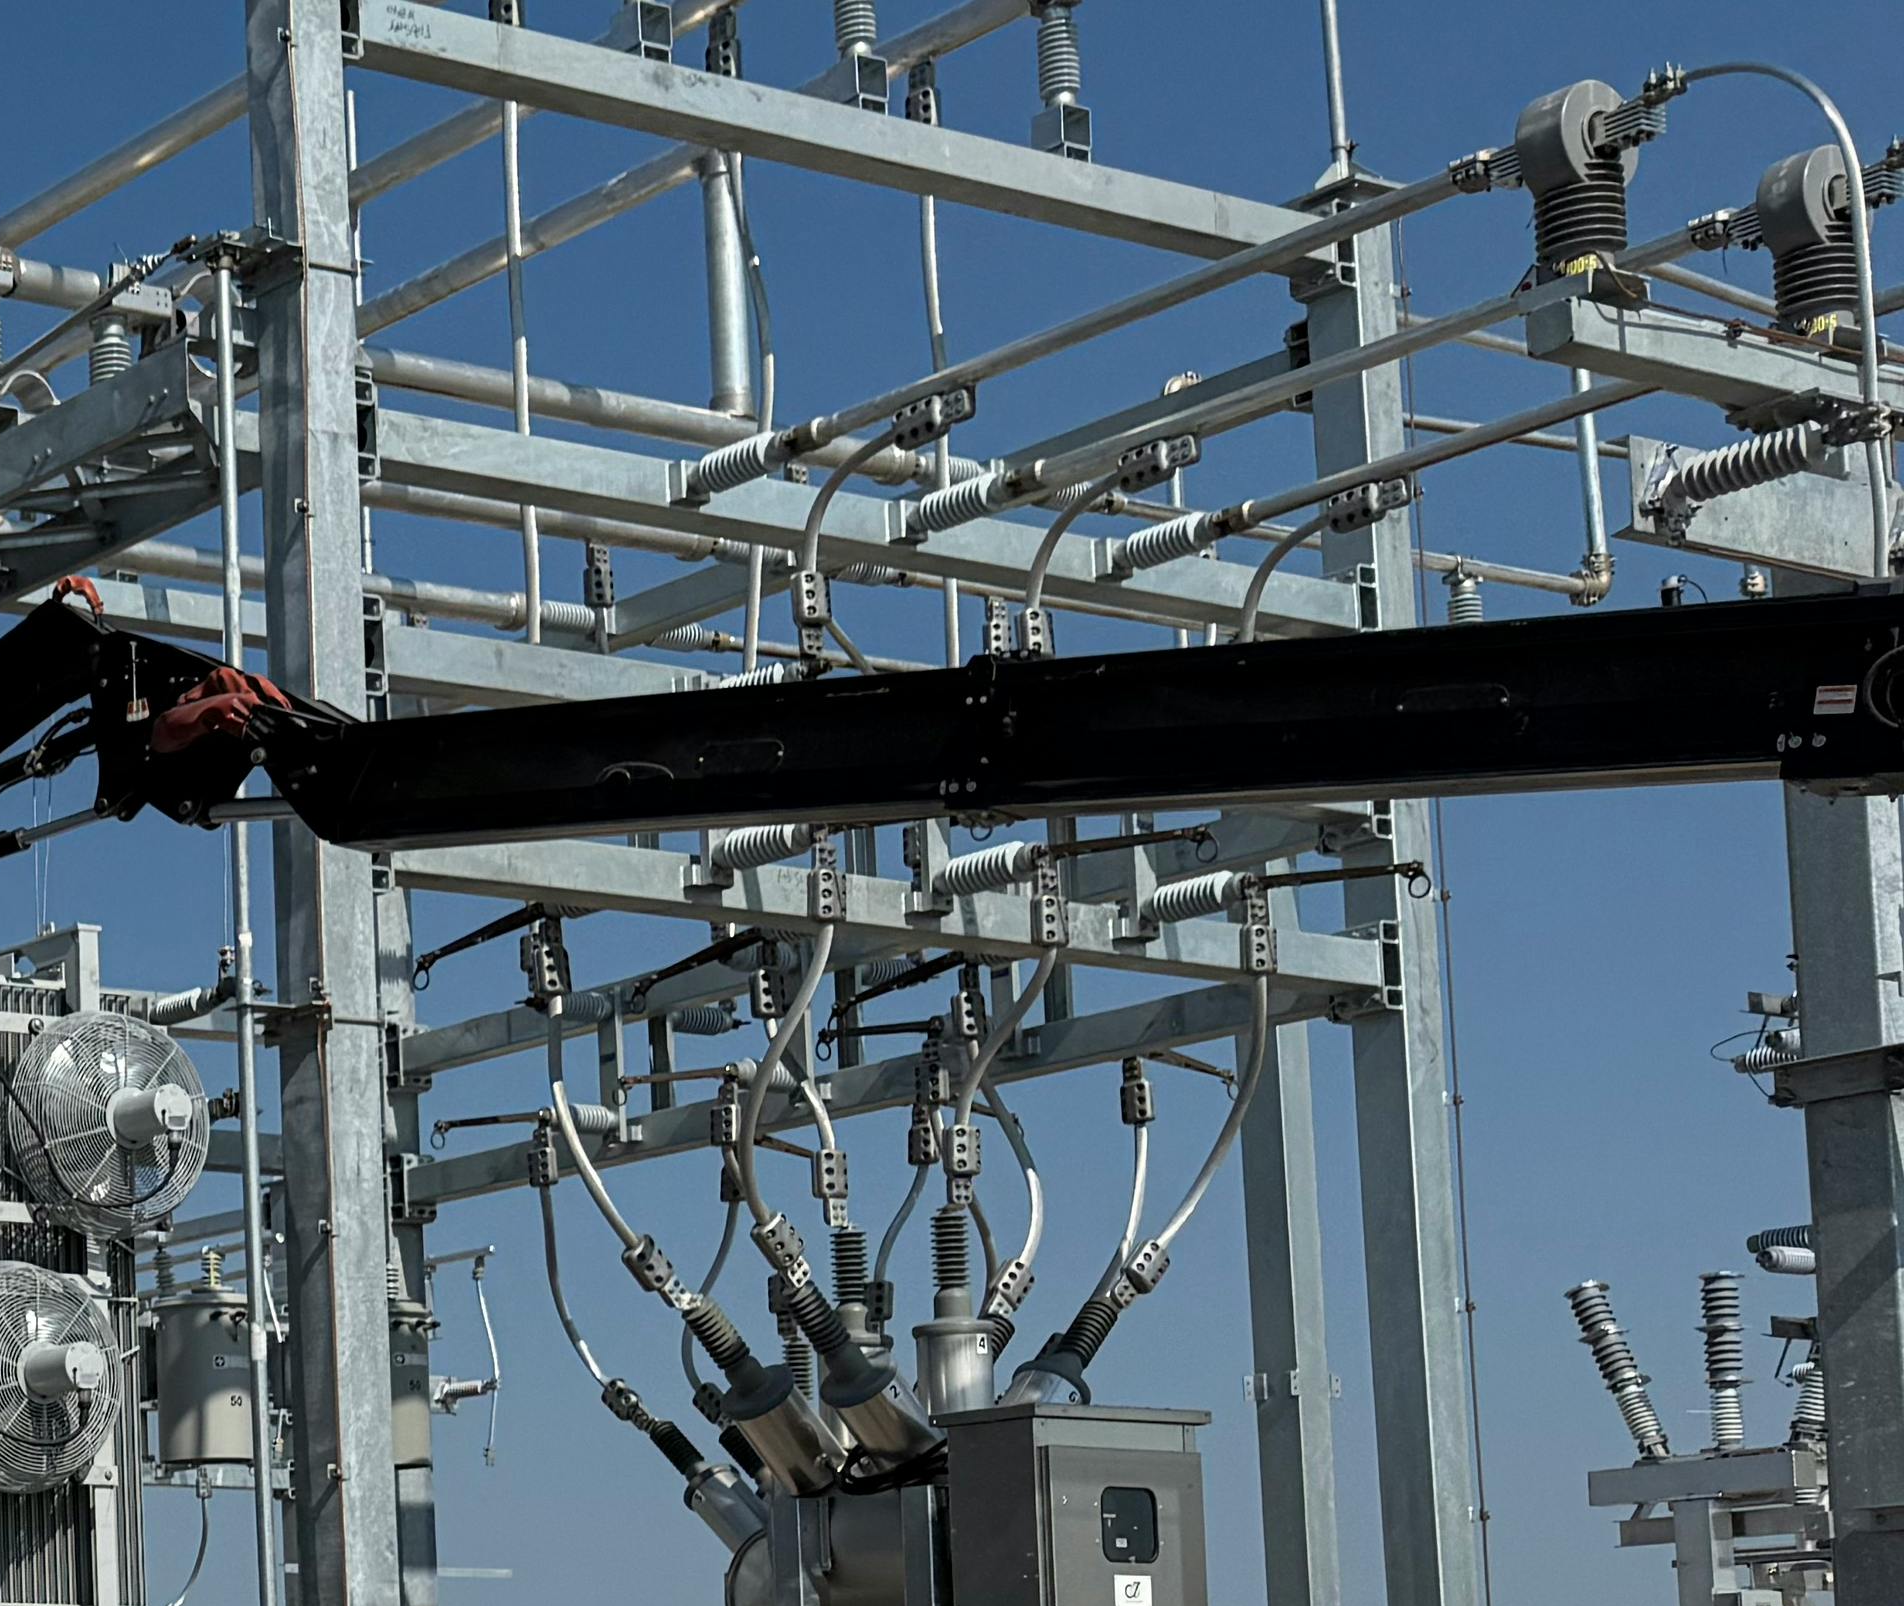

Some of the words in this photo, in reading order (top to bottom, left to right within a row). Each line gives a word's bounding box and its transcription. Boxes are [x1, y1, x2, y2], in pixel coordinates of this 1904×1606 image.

[979, 1337, 986, 1349] 4
[889, 1384, 900, 1400] 2
[230, 1395, 243, 1407] 50
